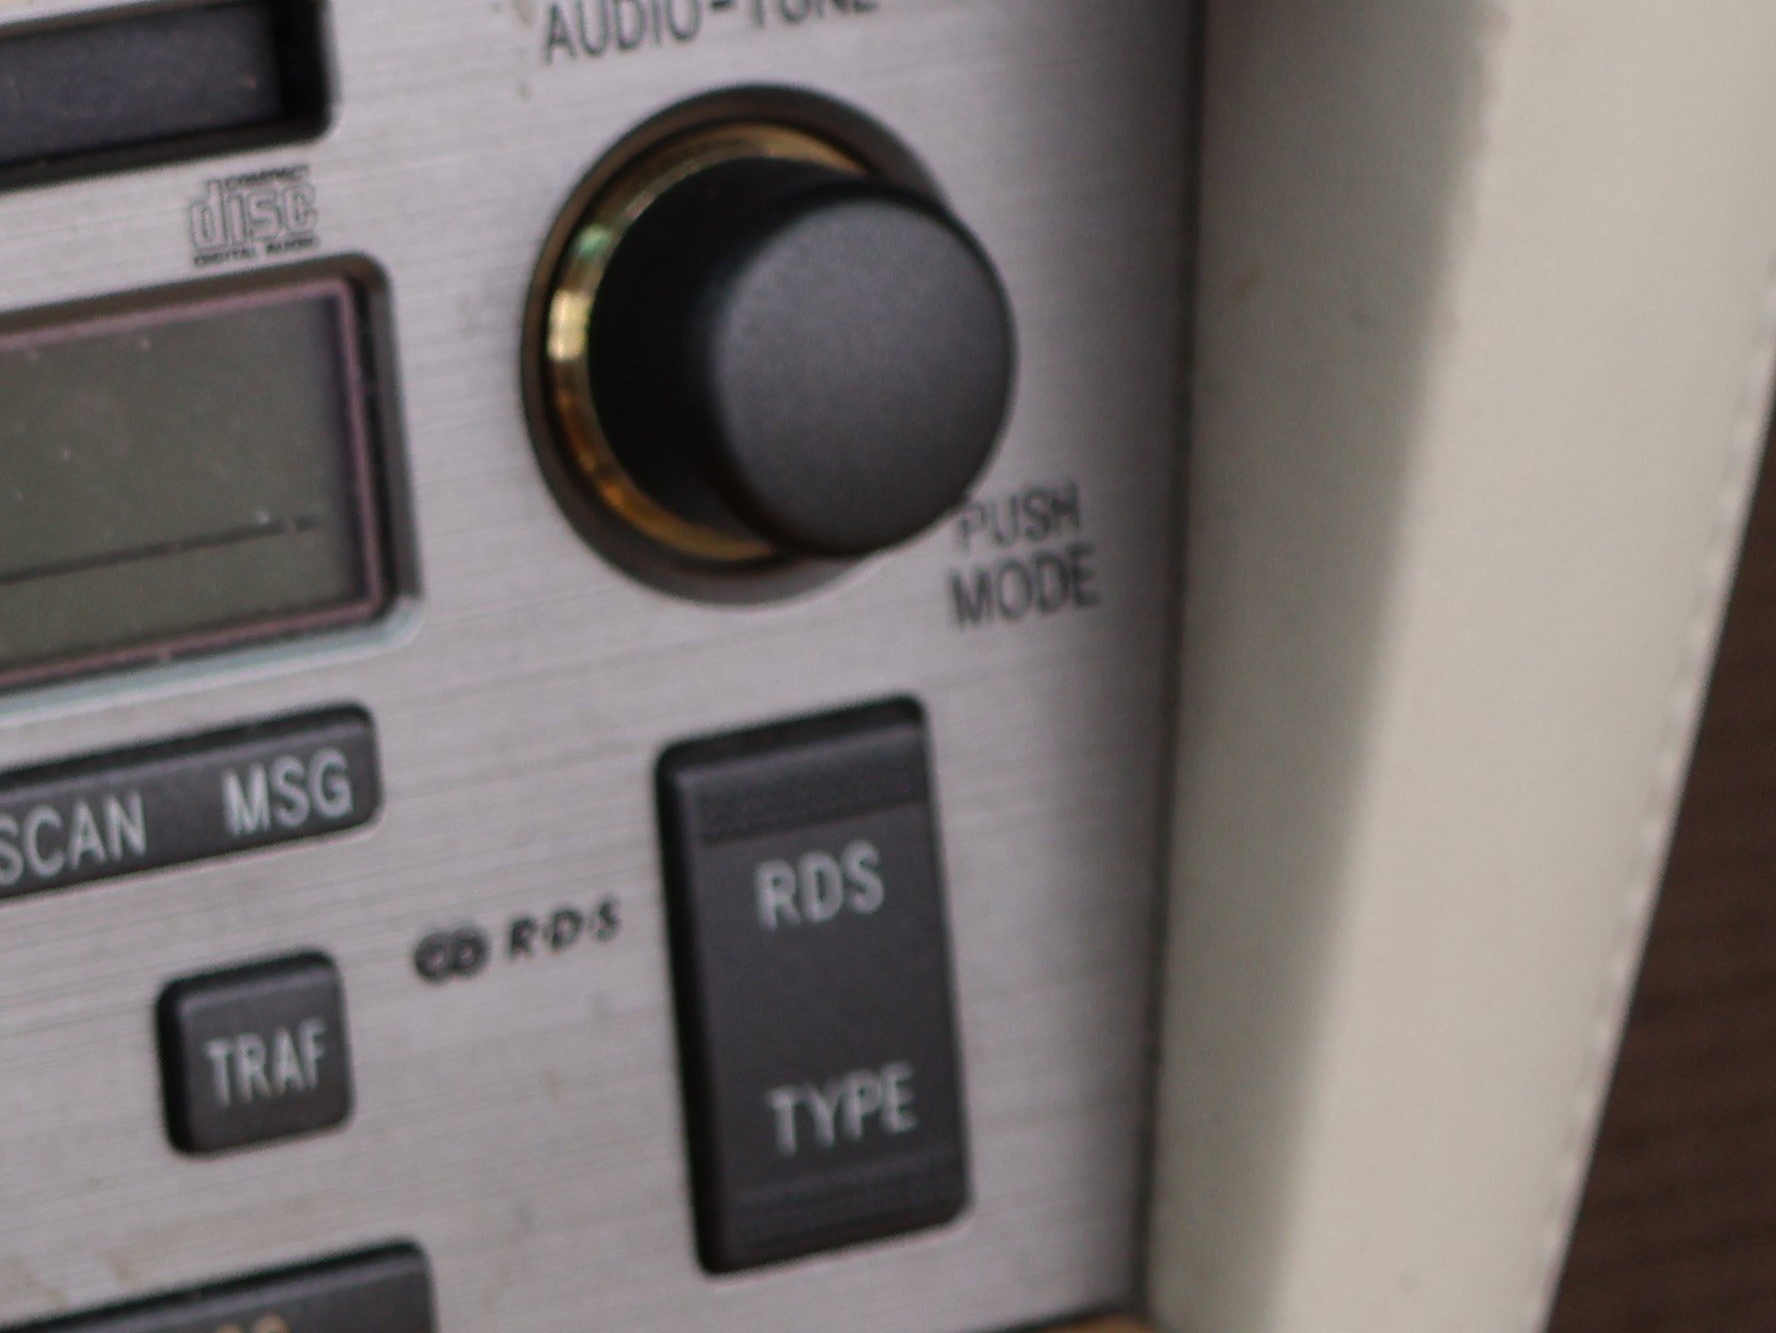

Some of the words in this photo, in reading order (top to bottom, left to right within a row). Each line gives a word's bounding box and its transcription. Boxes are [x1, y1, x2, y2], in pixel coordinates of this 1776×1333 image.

[954, 481, 1083, 554] PUSH
[949, 543, 1103, 632] MODE
[223, 744, 354, 836] MSG
[755, 843, 887, 930] RDS
[203, 1017, 328, 1109] TRAF
[764, 1061, 920, 1157] TYPE
